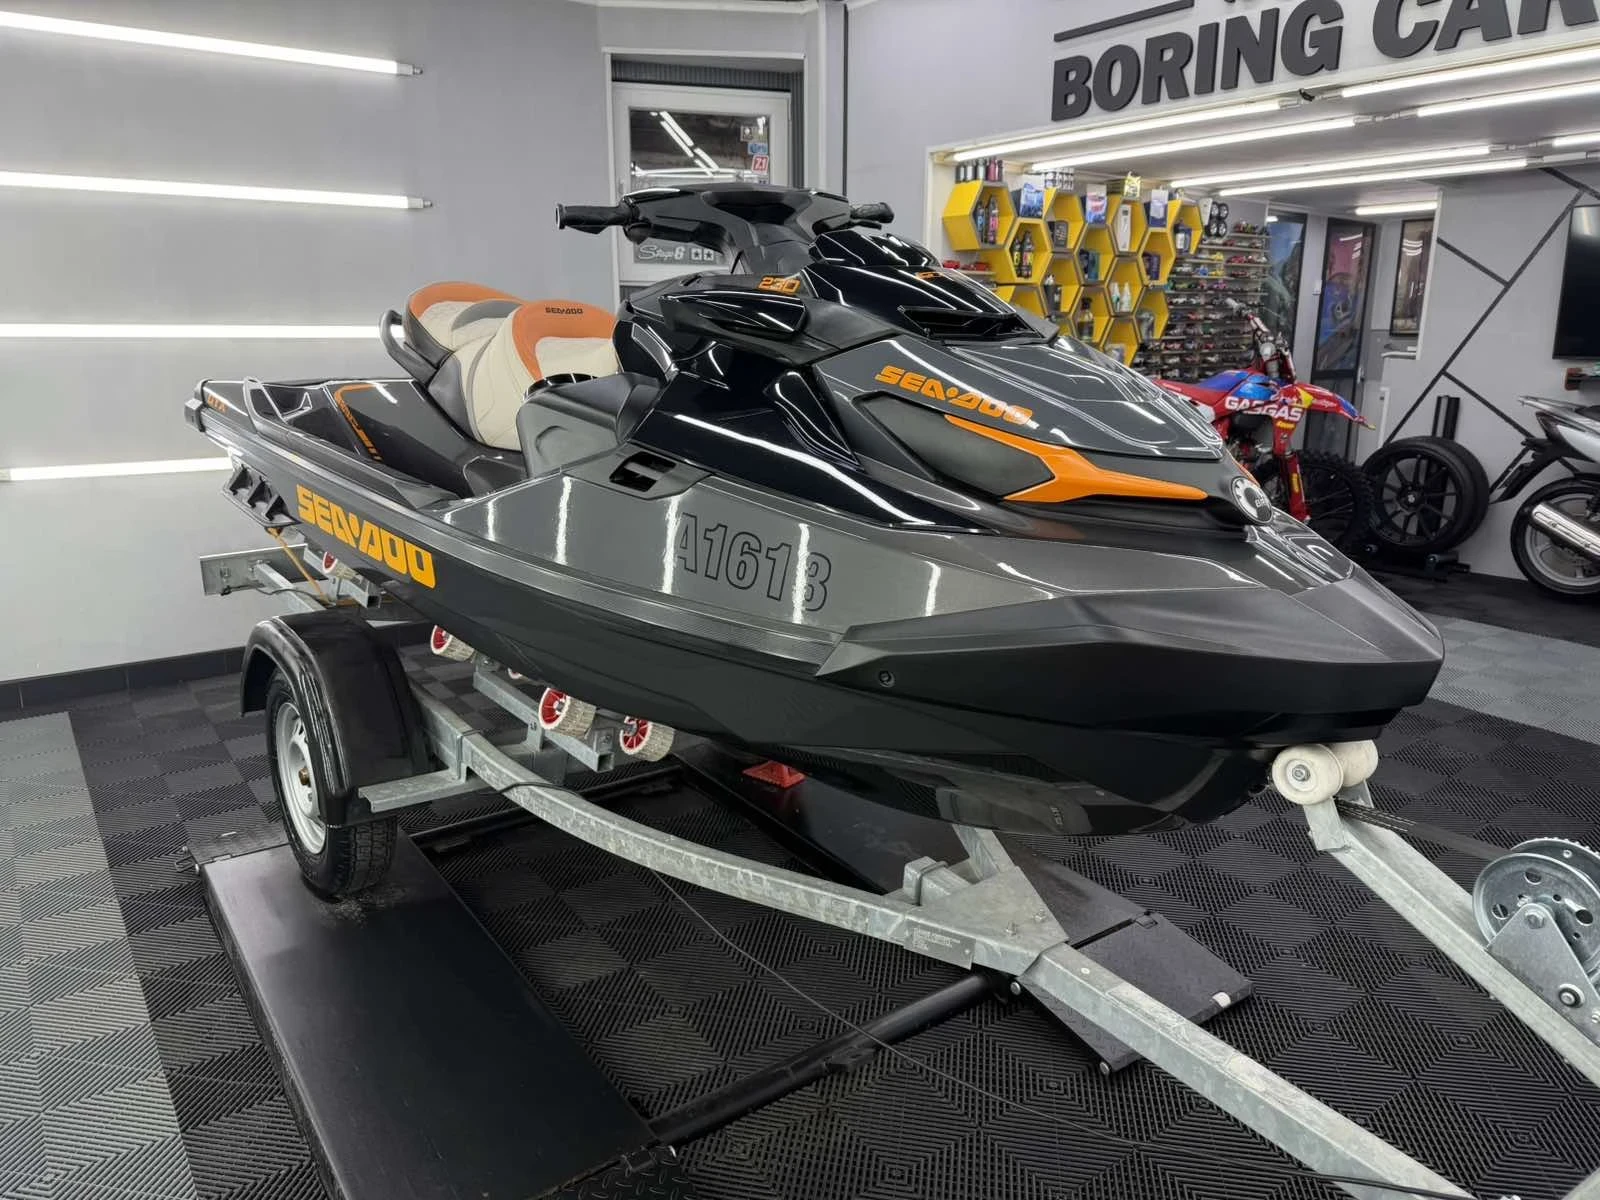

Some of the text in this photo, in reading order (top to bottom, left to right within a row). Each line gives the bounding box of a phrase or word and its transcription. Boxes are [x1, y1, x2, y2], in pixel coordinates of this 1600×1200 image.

[1051, 0, 1344, 121] BORING
[758, 276, 801, 293] 230
[1224, 395, 1303, 422] GASGAS
